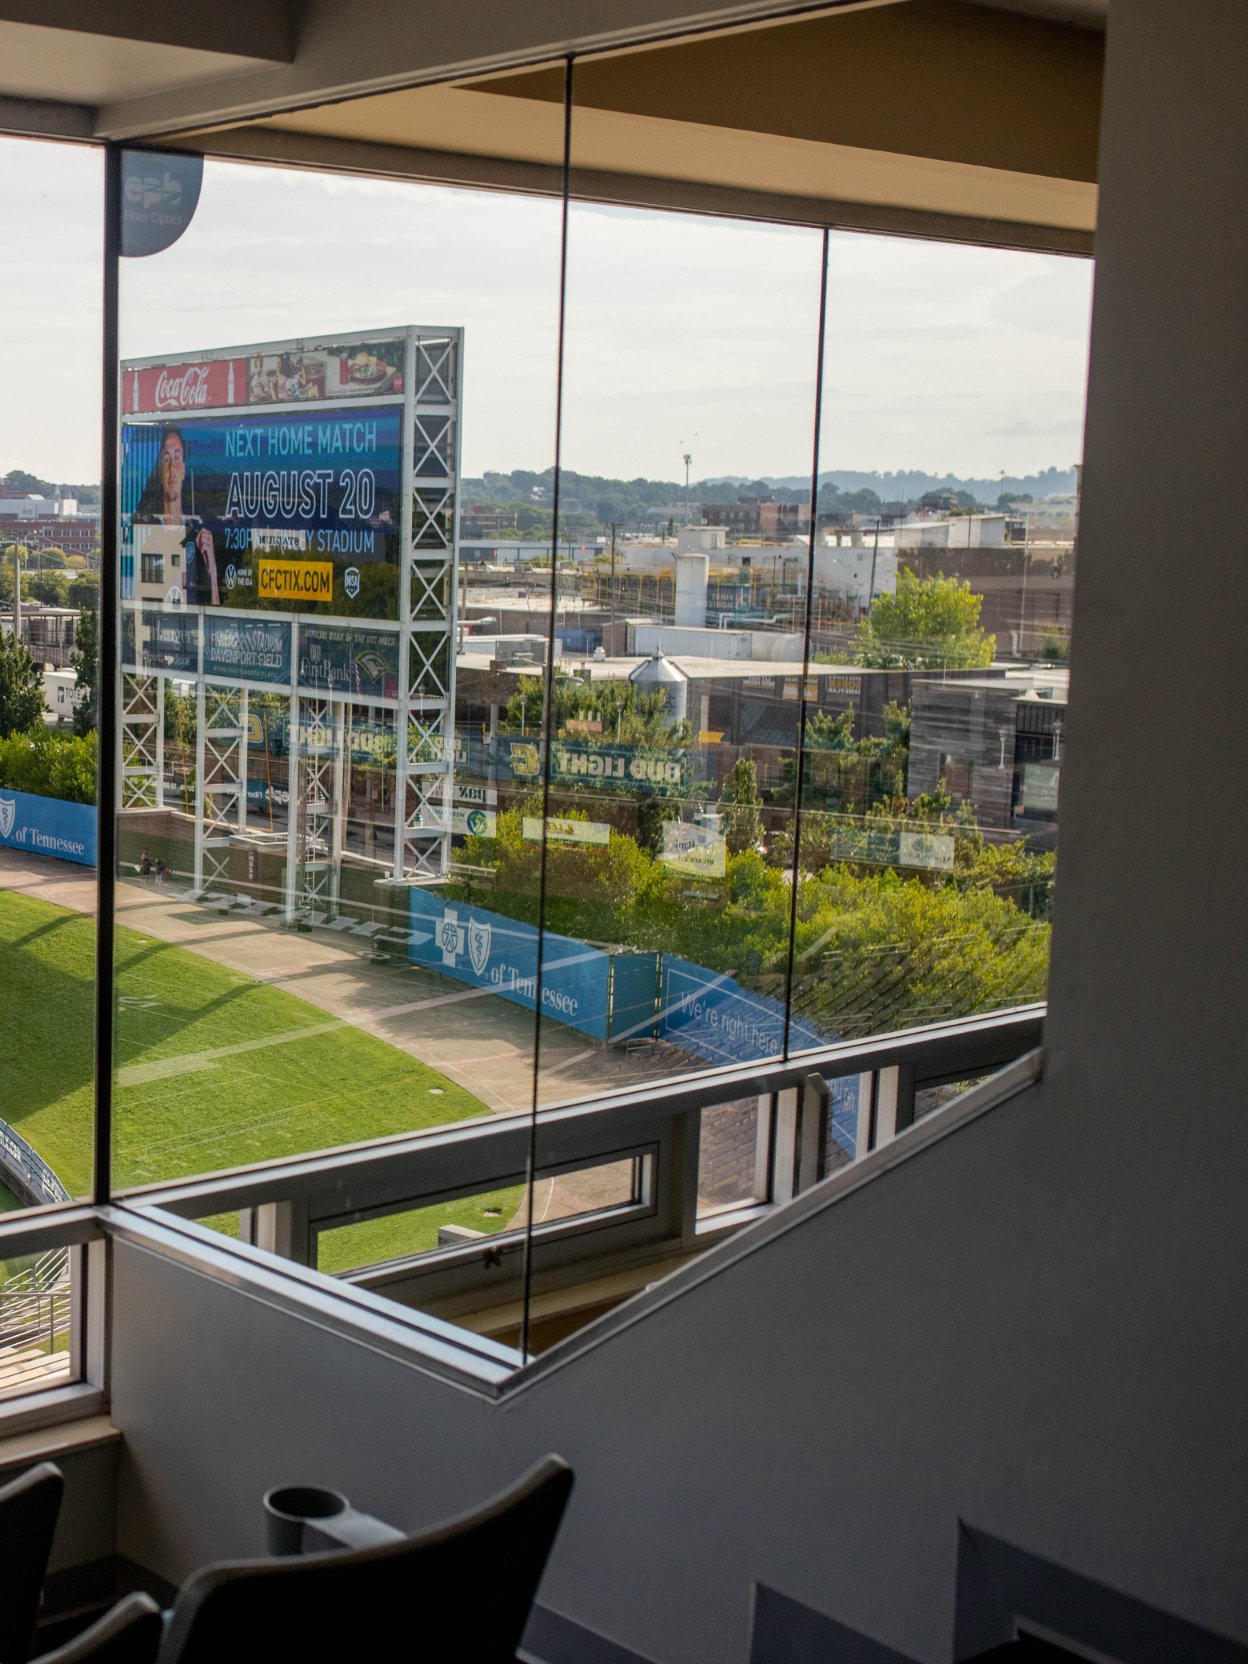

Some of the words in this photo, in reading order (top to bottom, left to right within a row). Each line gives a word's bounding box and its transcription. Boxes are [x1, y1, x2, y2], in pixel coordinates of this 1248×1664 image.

[124, 172, 182, 210] epb
[124, 208, 149, 222] Fiber
[150, 212, 183, 225] Optics
[155, 366, 210, 407] Coca-Cola
[225, 428, 264, 458] NEXT
[267, 425, 313, 456] HOME
[317, 422, 377, 454] MATCH
[225, 469, 334, 519] AUGUST
[338, 468, 376, 519] 20
[317, 528, 375, 553] STADIUM
[260, 567, 330, 593] CFCTIX.COM
[210, 647, 258, 666] DAVENPORT
[16, 828, 28, 843] of
[29, 828, 84, 856] Tennessee
[490, 963, 506, 984] of
[681, 991, 718, 1027] We're
[720, 1013, 748, 1043] right
